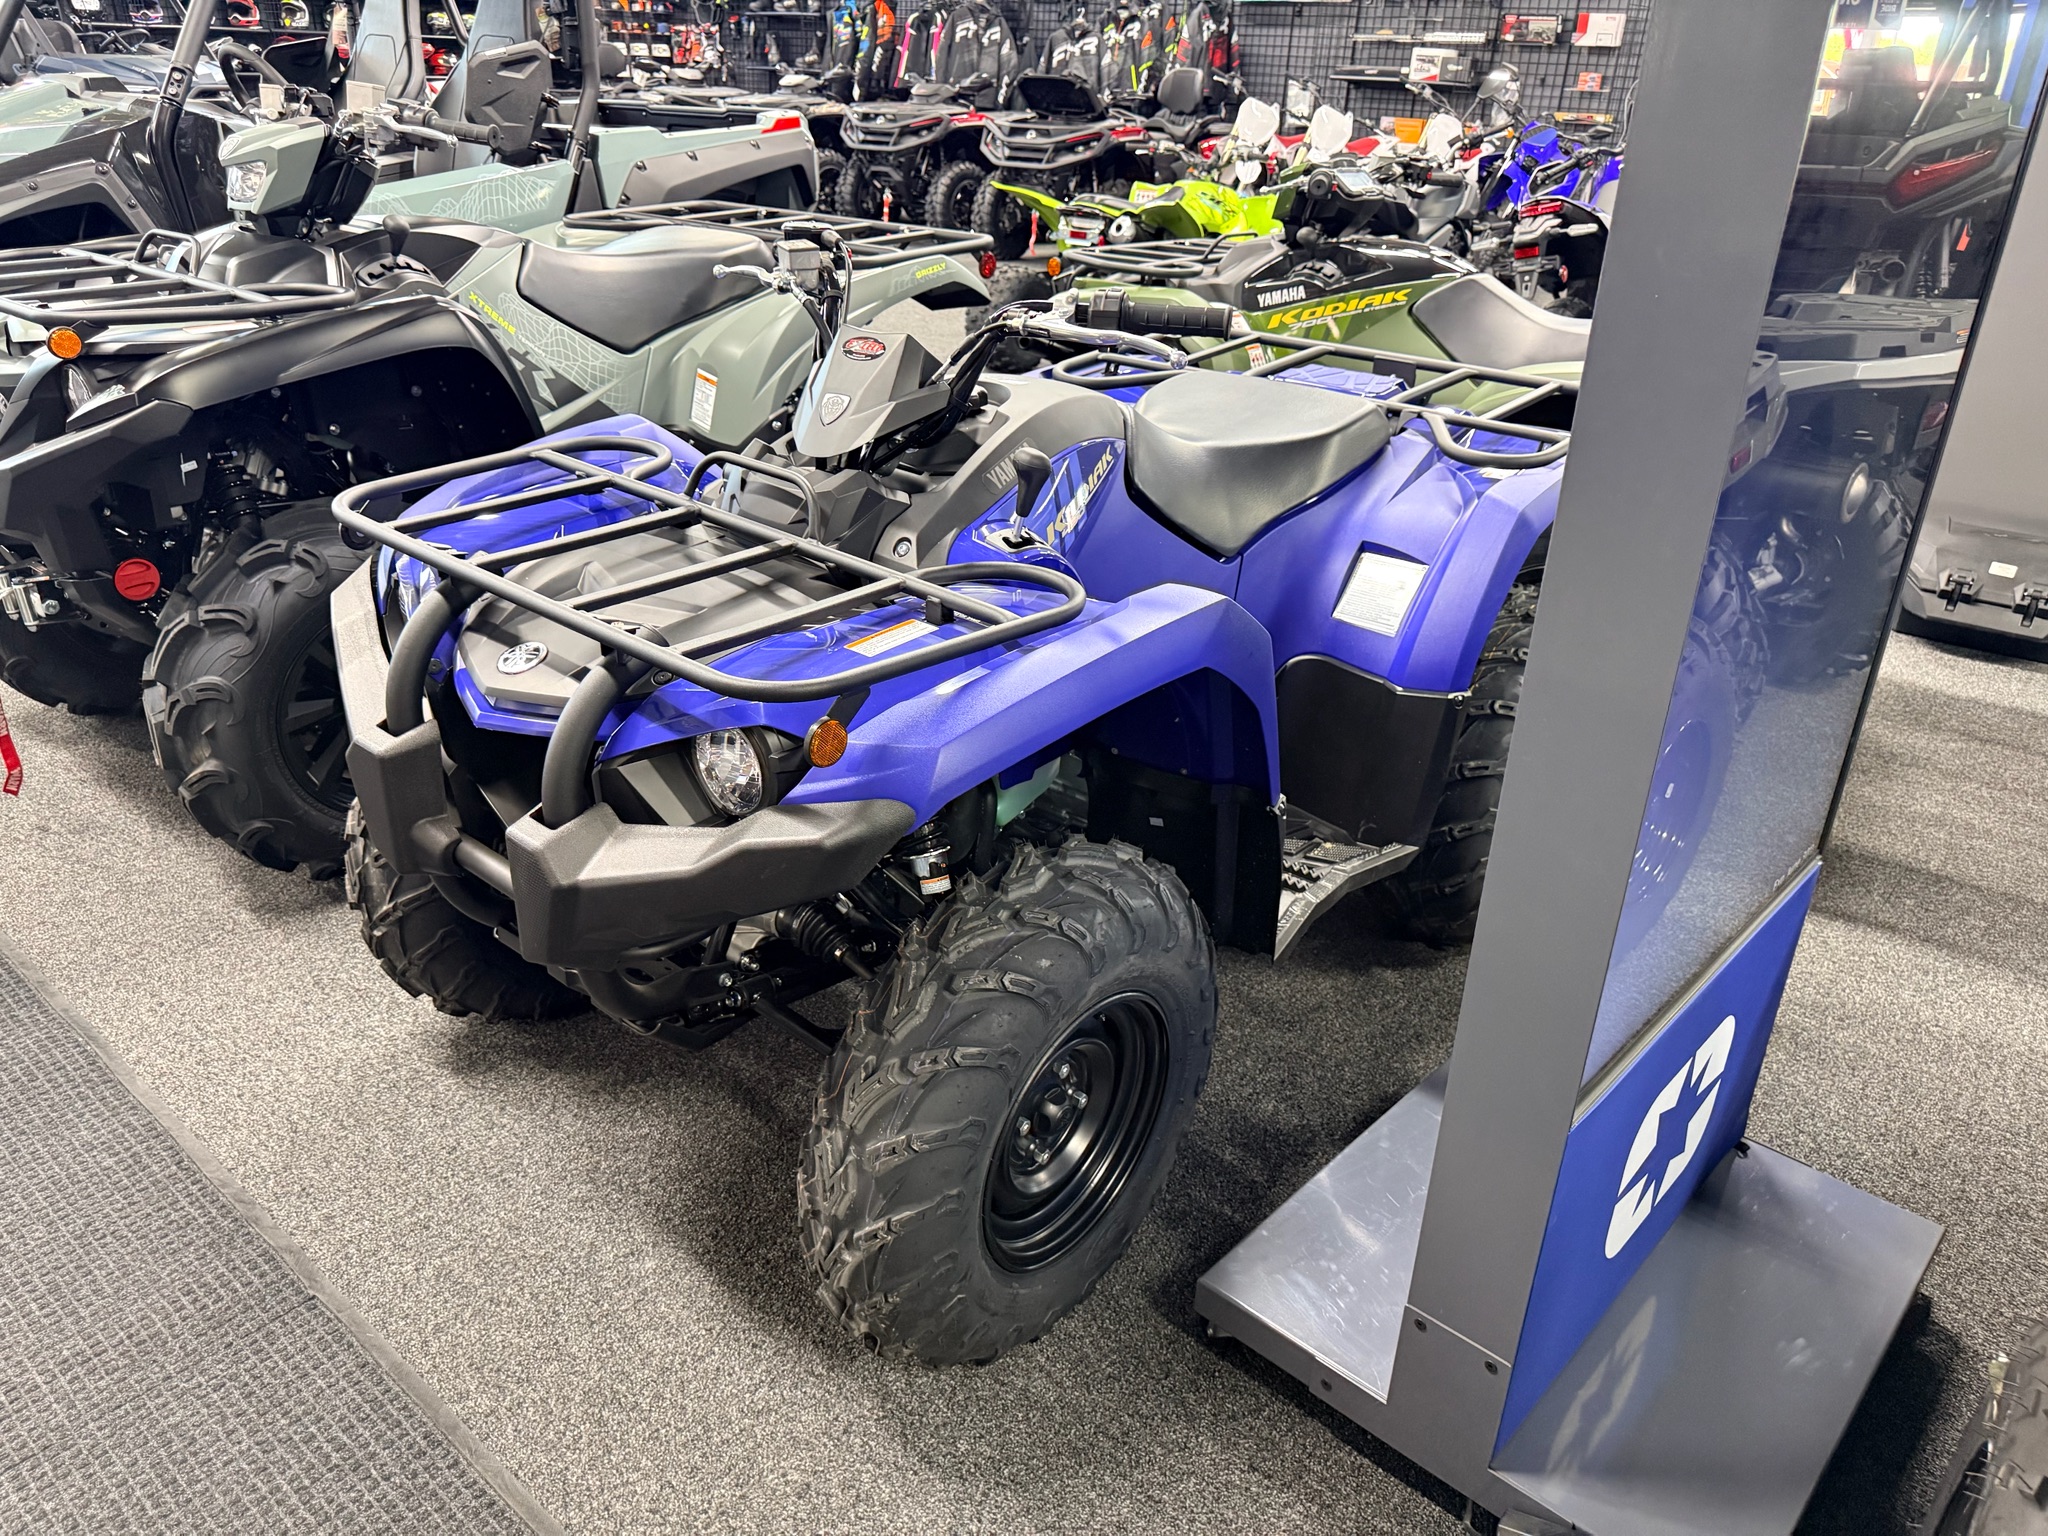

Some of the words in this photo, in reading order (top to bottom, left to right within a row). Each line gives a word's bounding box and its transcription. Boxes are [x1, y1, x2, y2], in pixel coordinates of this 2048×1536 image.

[1052, 36, 1098, 67] FXR
[915, 262, 946, 279] GRIZZLY
[1257, 285, 1306, 308] YAMAHA
[1267, 288, 1412, 329] KODIAK
[469, 291, 516, 335] XTREME
